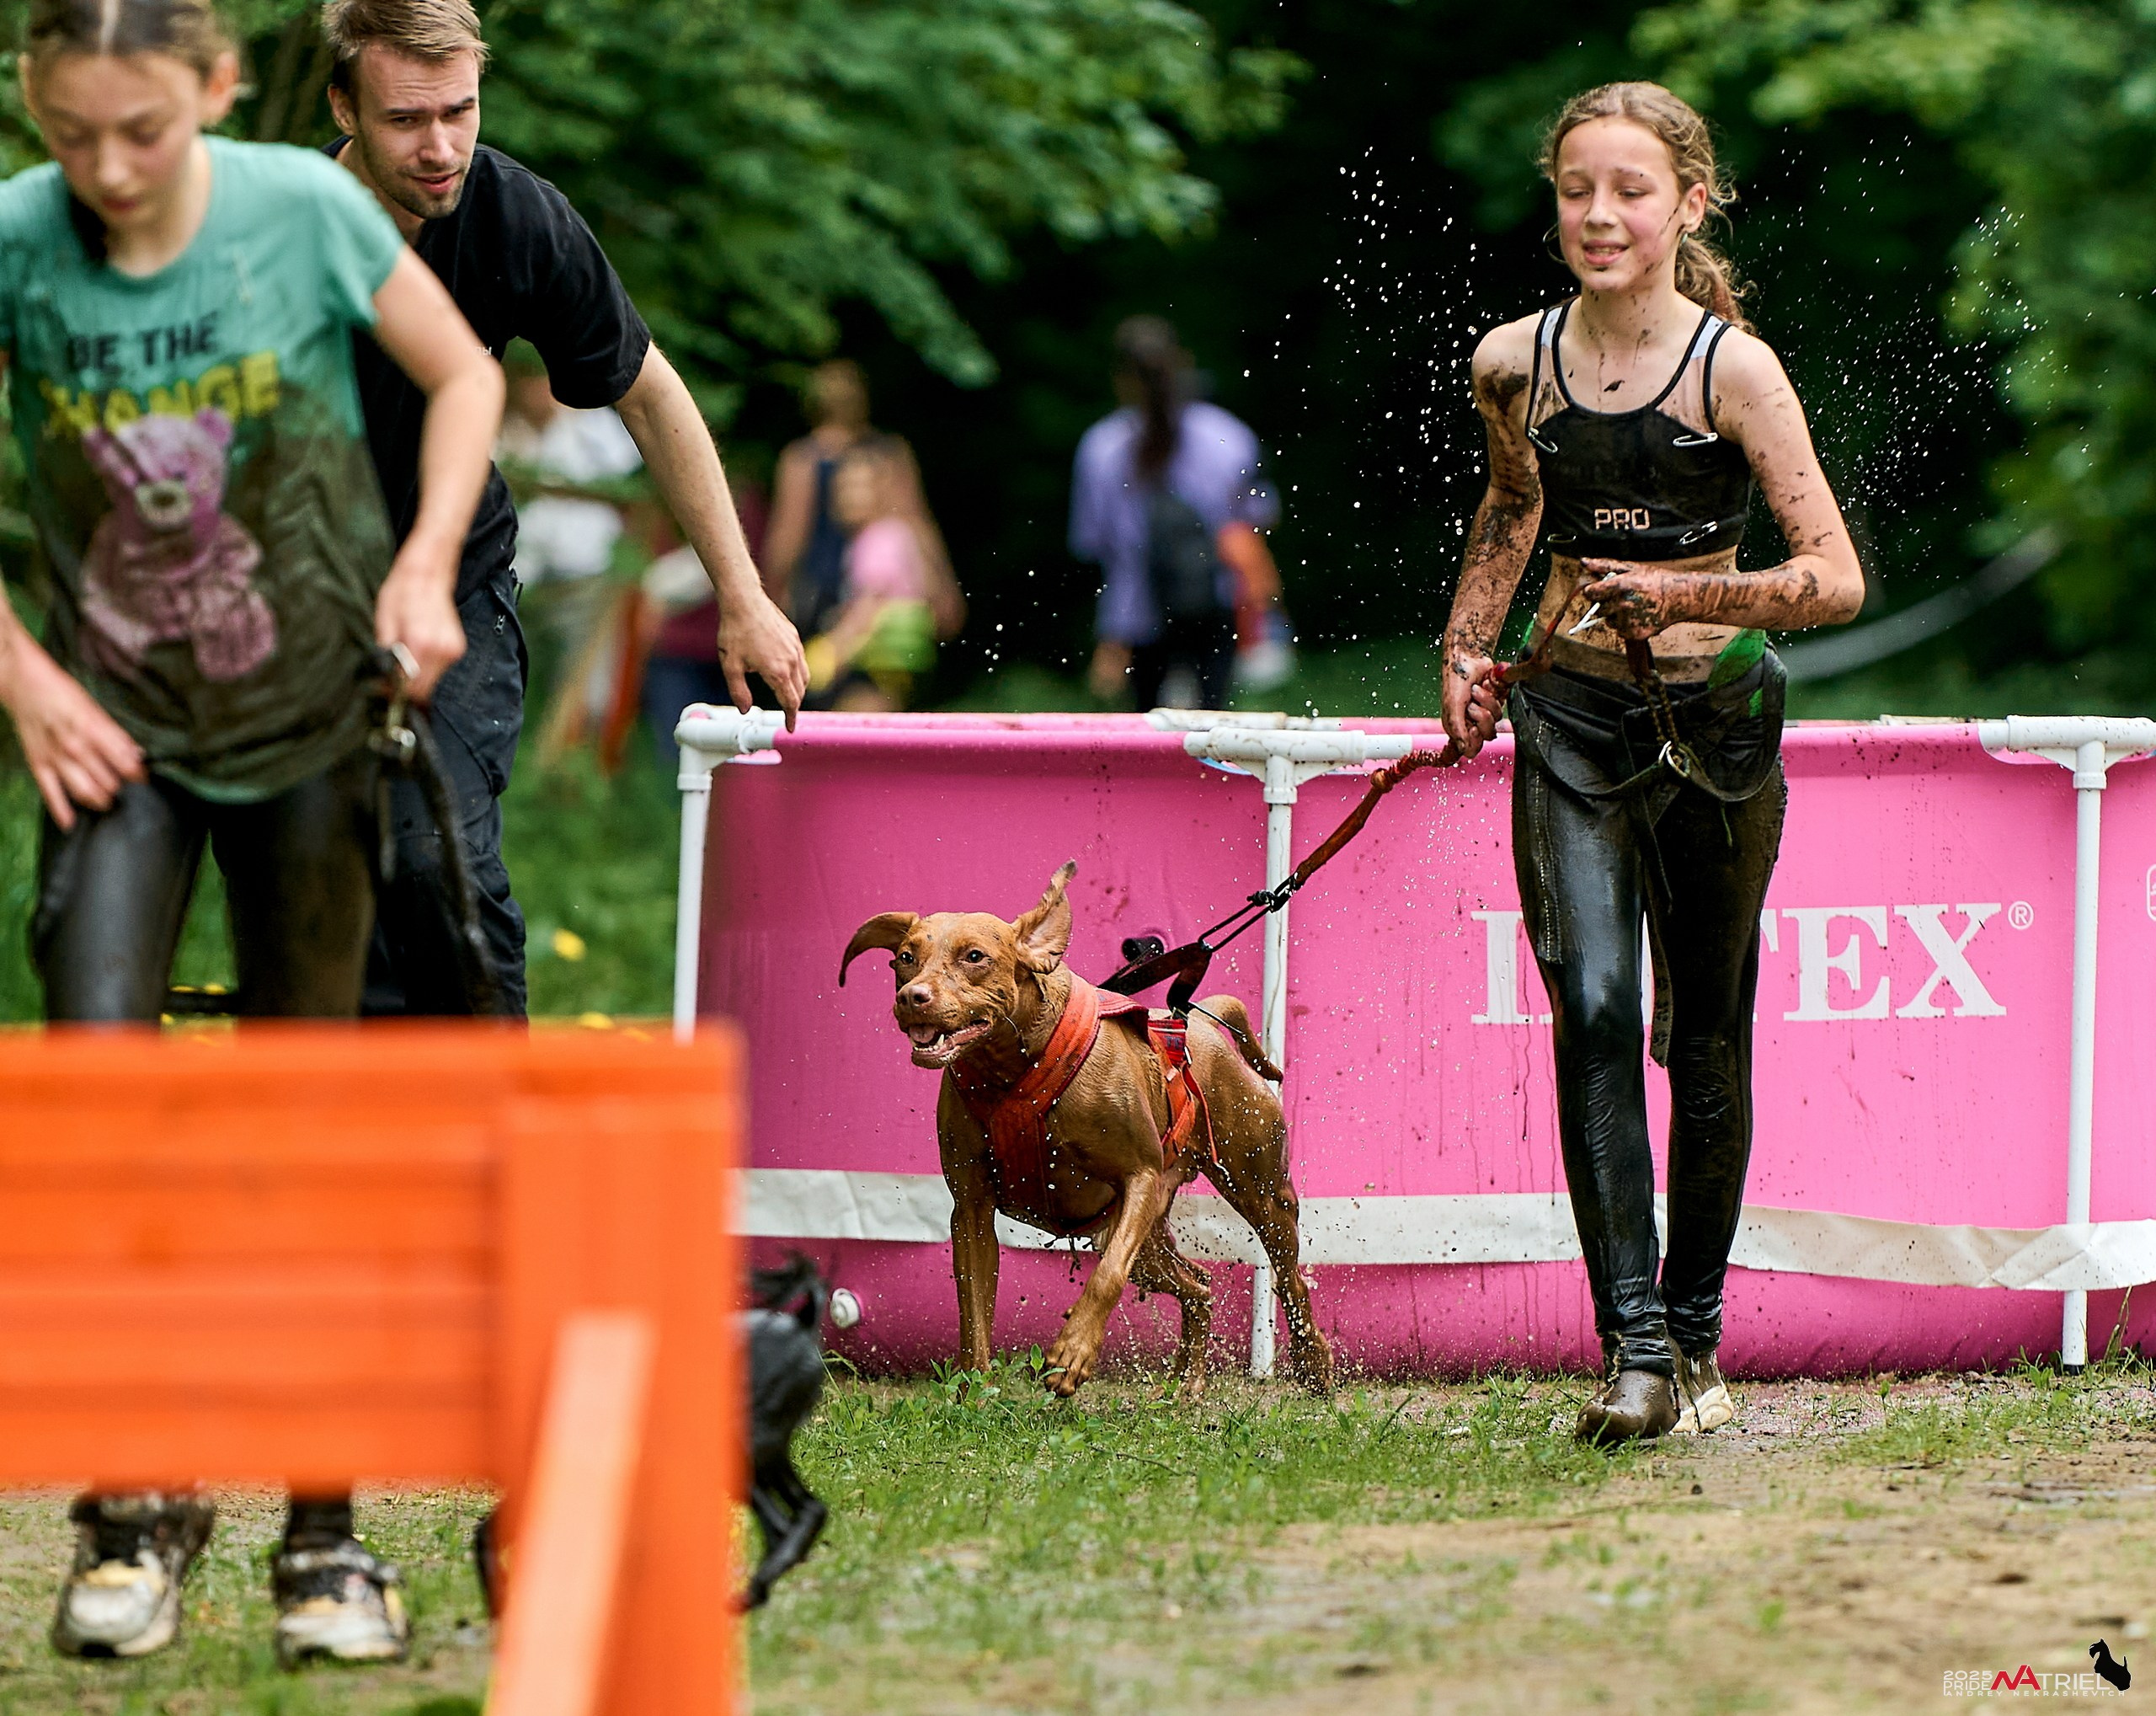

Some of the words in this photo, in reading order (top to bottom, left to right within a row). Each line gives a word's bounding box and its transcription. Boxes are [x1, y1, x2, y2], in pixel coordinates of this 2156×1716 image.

[65, 332, 120, 372] BE
[137, 311, 218, 367] THE
[1594, 508, 1651, 531] PRO
